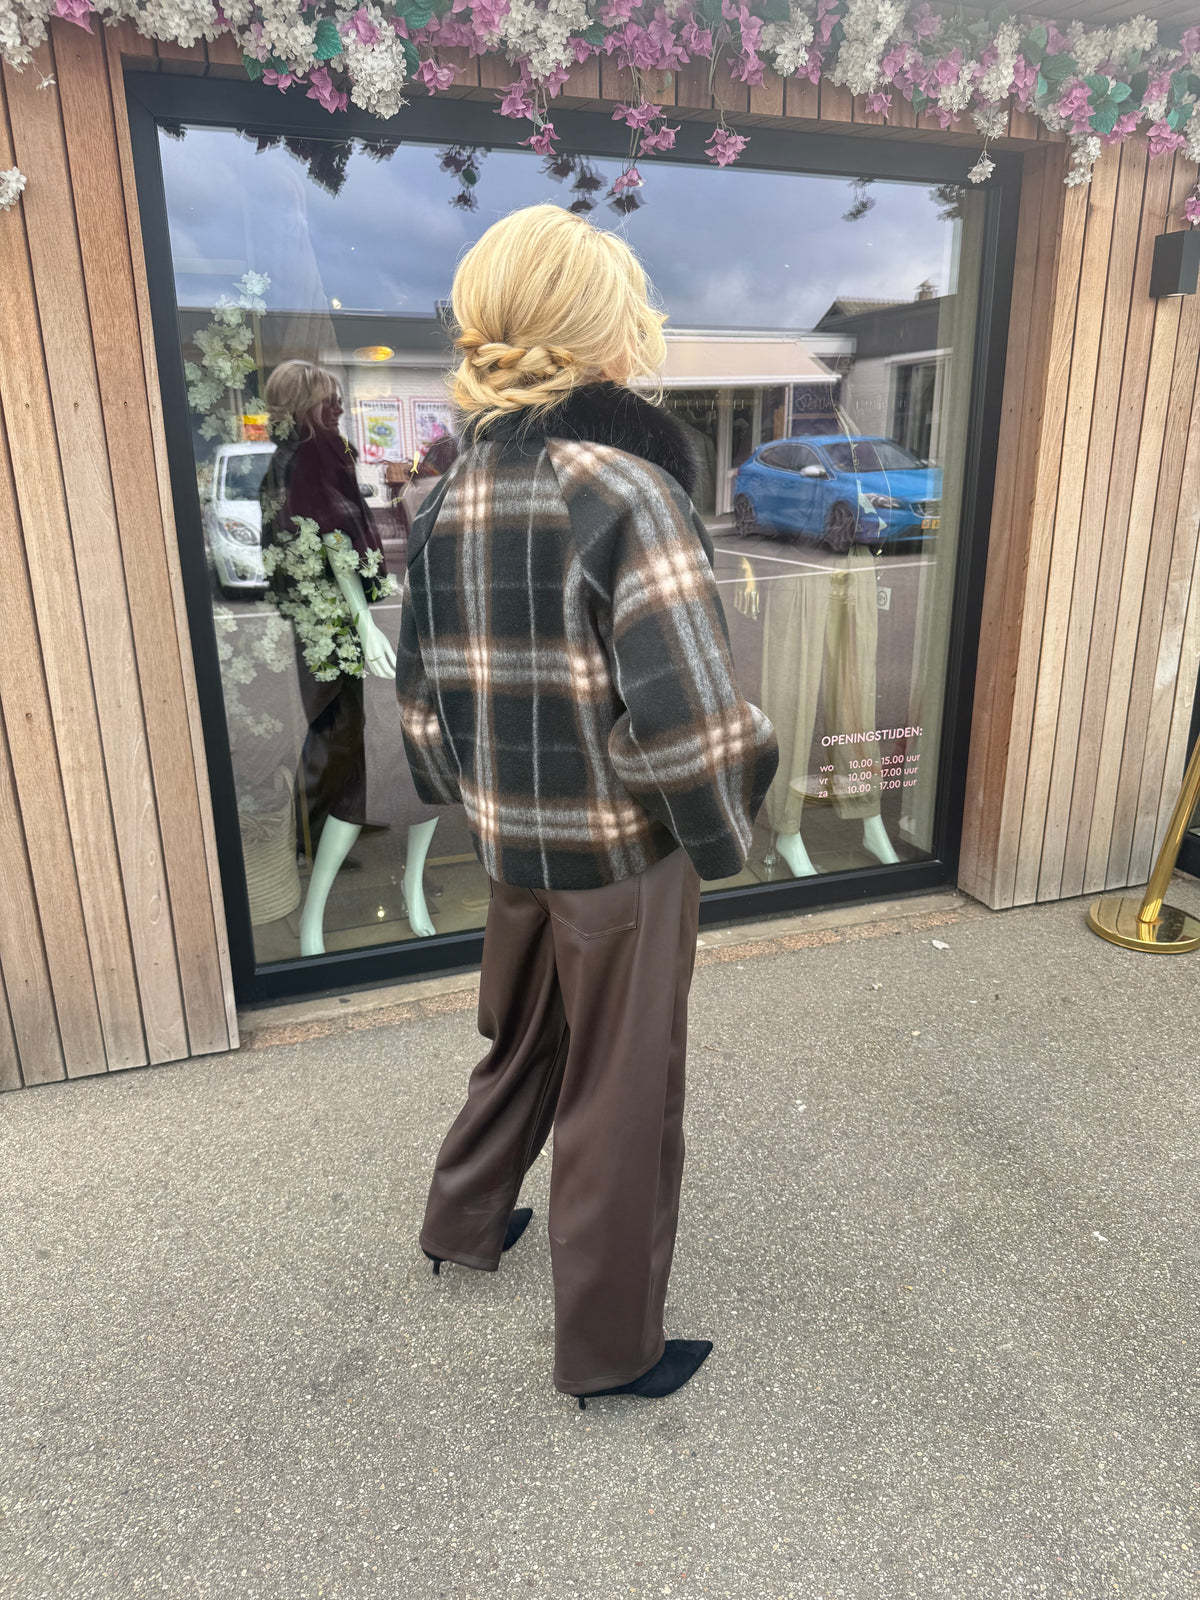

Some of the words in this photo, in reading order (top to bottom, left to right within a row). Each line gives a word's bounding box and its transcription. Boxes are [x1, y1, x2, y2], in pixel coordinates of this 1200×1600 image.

[821, 726, 923, 746] OPENINGSTIJDEN:
[820, 764, 834, 773] wo
[849, 758, 873, 769] 10.00
[881, 754, 904, 765] 15.00
[906, 753, 921, 762] uur
[819, 777, 829, 785] vr
[848, 771, 872, 782] 10.00
[880, 767, 902, 778] 17.00
[904, 766, 919, 775] uur
[818, 790, 828, 798] za
[847, 783, 871, 794] 10.00
[879, 779, 901, 790] 17.00
[903, 778, 918, 787] uur
